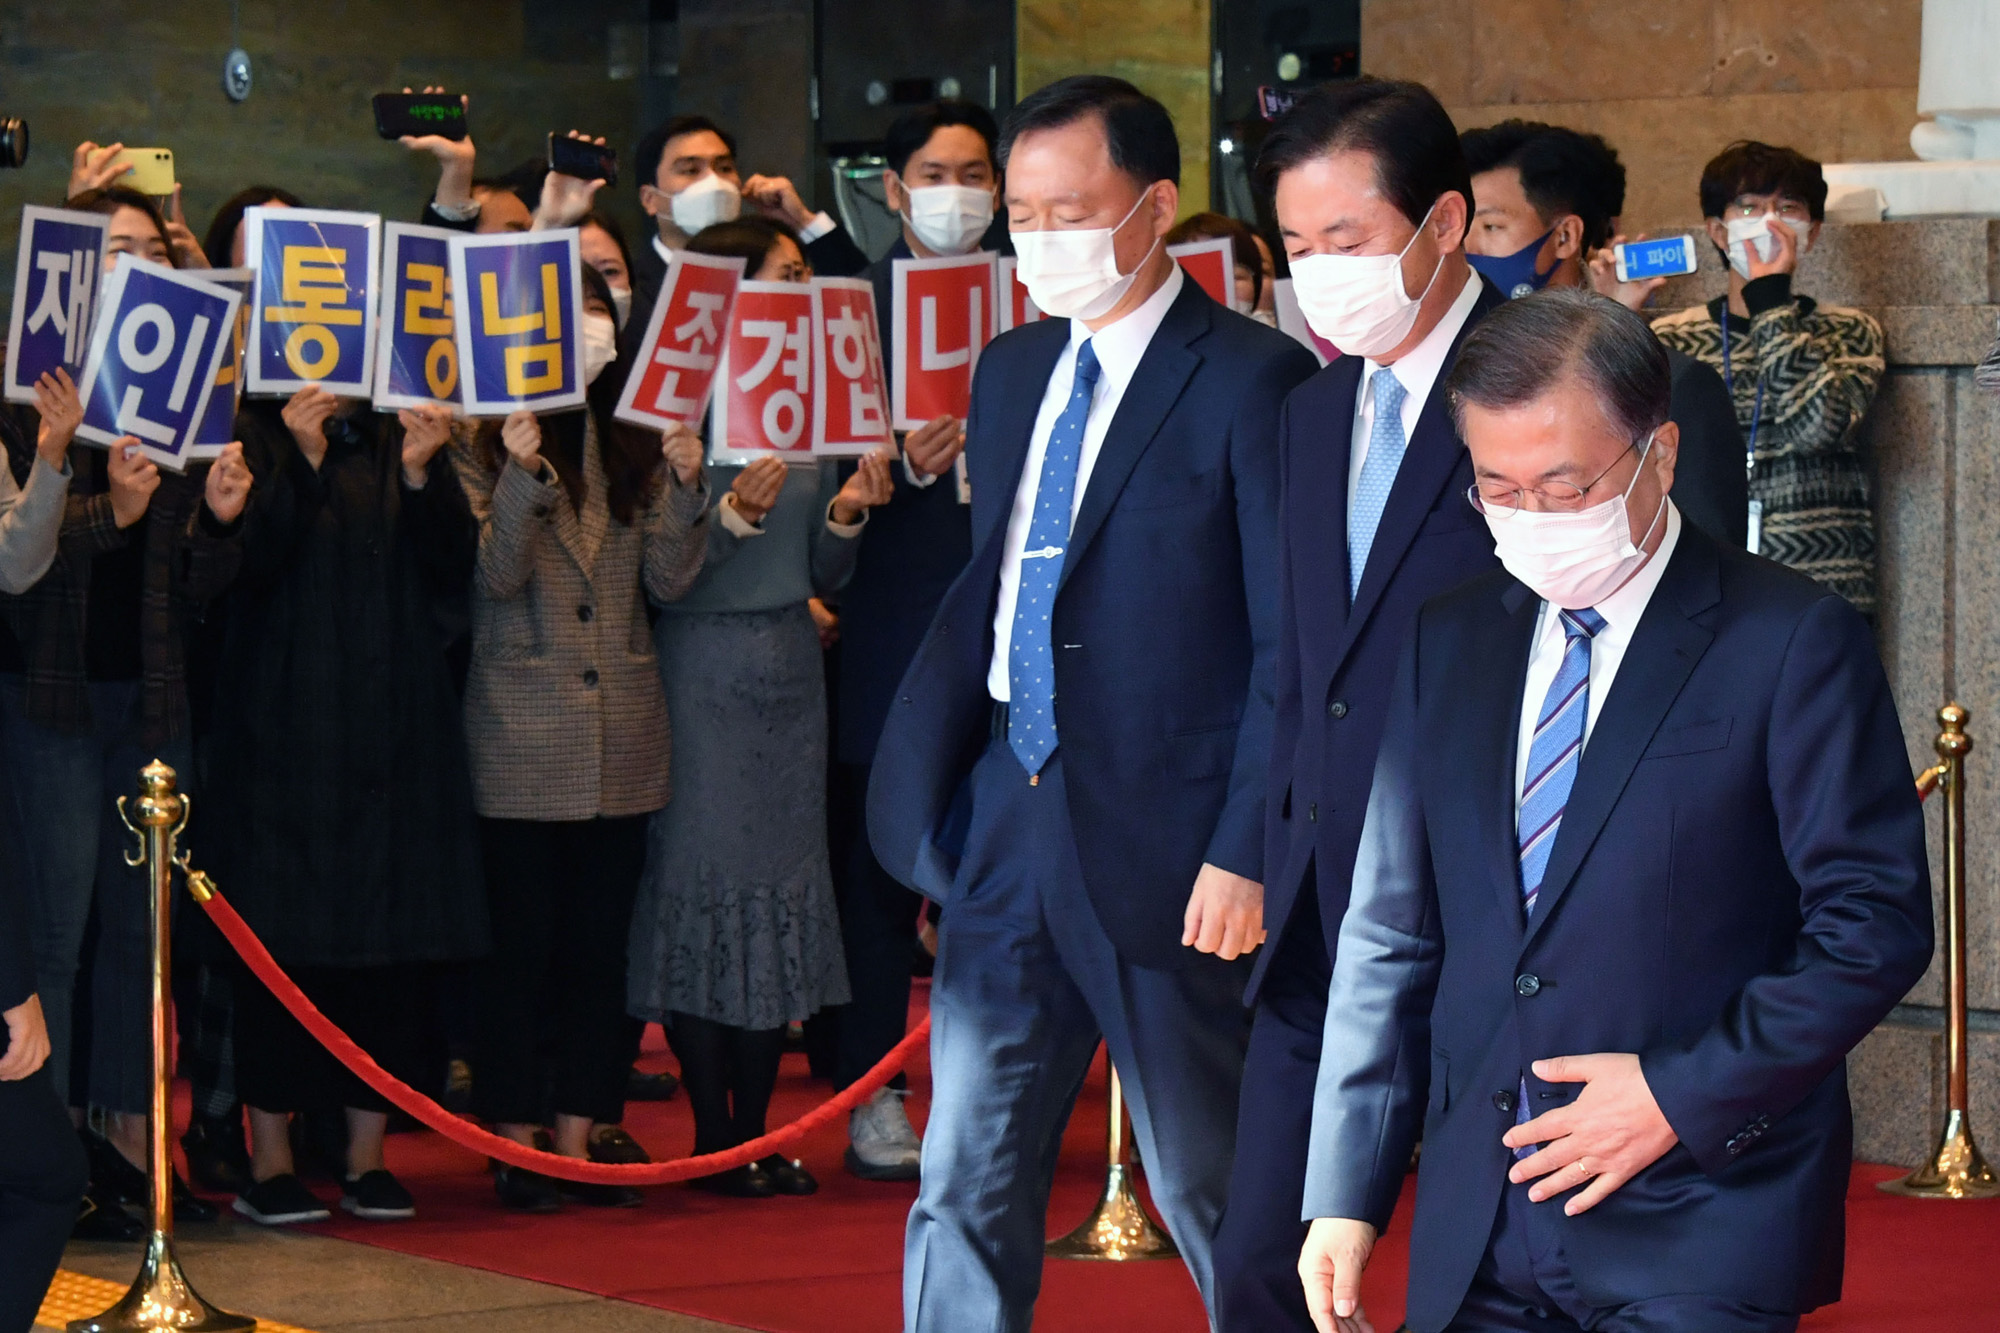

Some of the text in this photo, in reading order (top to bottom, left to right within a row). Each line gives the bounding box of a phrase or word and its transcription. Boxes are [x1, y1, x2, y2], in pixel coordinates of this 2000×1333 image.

[409, 105, 461, 121] 사랑합니
[27, 249, 95, 367] 재
[265, 246, 362, 379] 통
[1647, 245, 1686, 267] 파이
[117, 303, 210, 446] 인
[479, 263, 562, 396] 님
[655, 291, 725, 414] 존
[736, 316, 809, 449] 경
[827, 306, 887, 436] 합
[921, 286, 982, 393] 니
